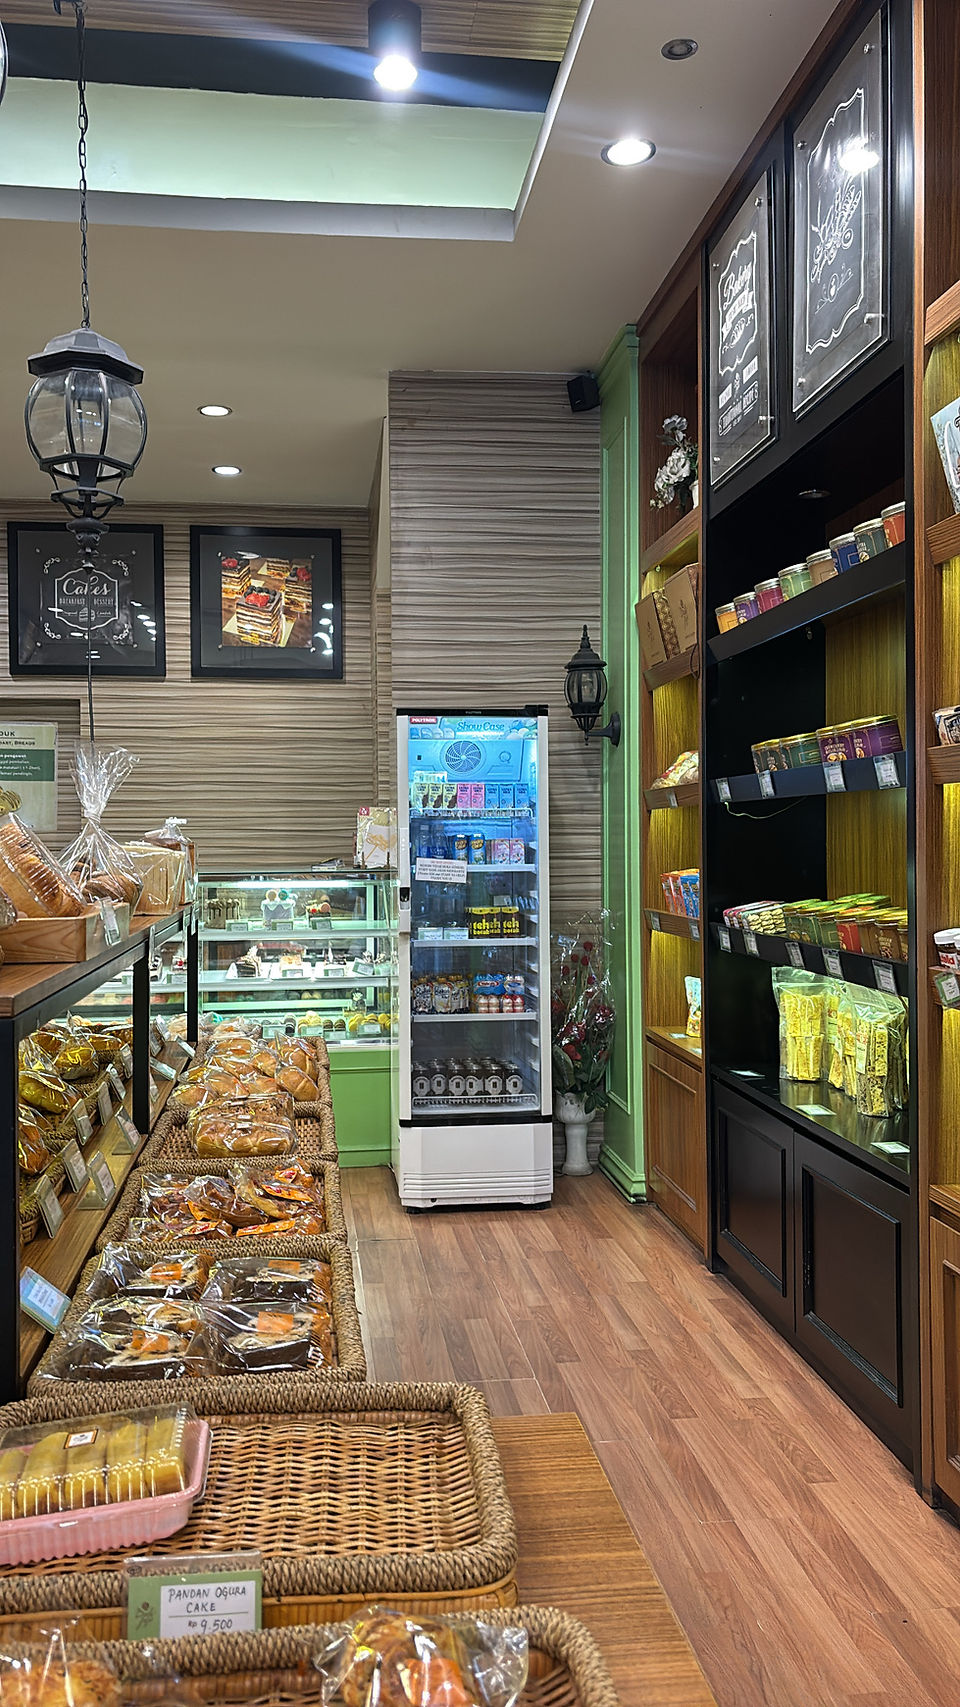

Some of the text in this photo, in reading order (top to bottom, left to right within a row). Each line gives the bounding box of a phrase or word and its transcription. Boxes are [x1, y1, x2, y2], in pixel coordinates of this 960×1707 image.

[63, 576, 111, 595] Cakes
[473, 919, 489, 929] teh
[503, 918, 519, 928] teh
[168, 1586, 246, 1602] PANDAN OGURA
[186, 1602, 216, 1613] CAKE
[200, 1619, 232, 1634] 9.500
